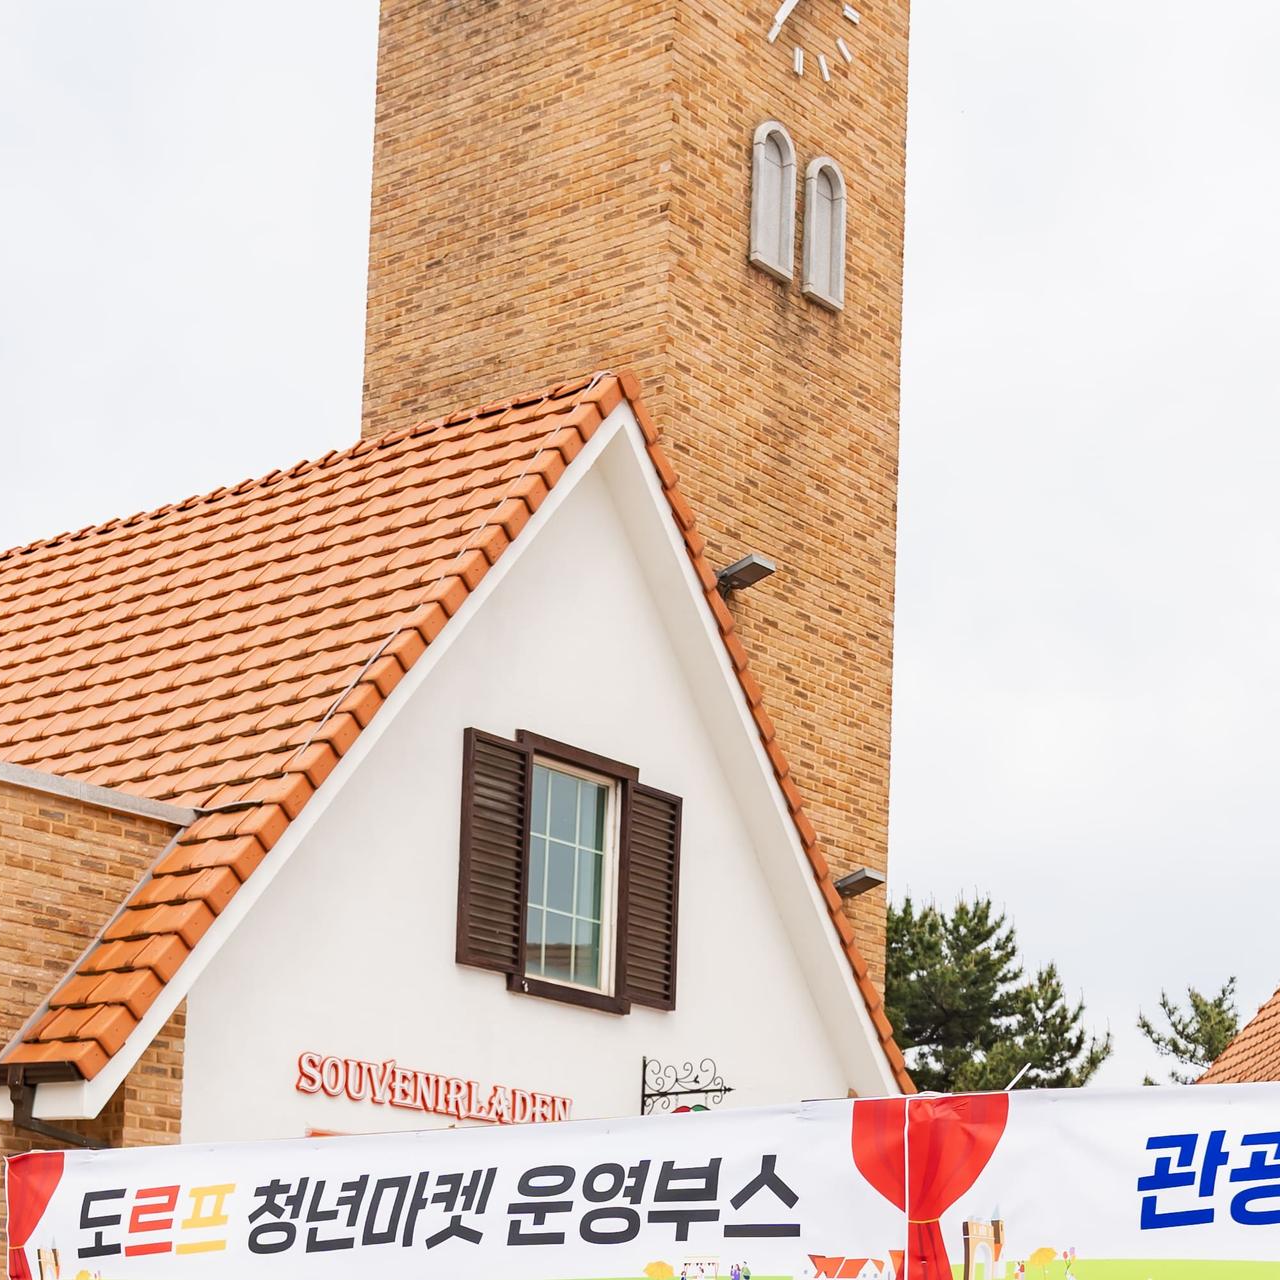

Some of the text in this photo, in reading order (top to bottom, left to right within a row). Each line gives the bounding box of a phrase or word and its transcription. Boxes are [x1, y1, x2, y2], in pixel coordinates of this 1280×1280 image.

[296, 1051, 573, 1124] SOUVENIRLADEN
[77, 1154, 801, 1259] 도르프 청년마켓 운영부스
